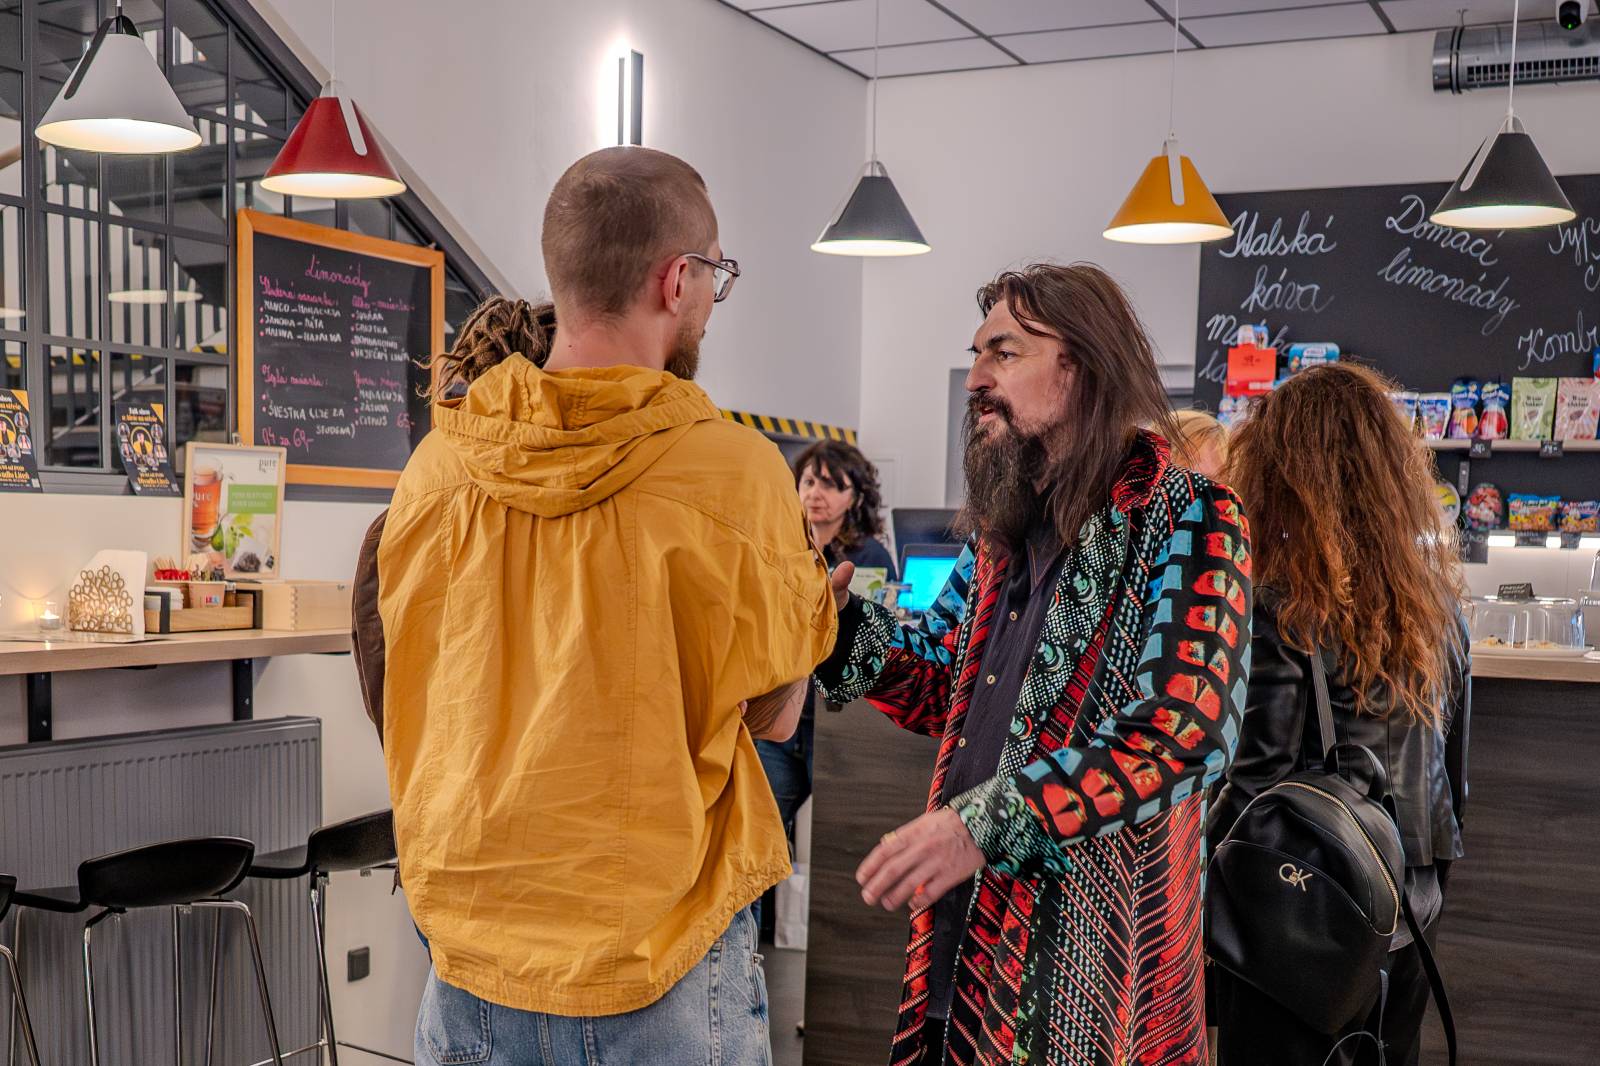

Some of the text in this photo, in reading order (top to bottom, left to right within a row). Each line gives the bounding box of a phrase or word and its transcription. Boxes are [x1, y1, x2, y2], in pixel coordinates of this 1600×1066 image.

[304, 254, 371, 298] Limonády
[1240, 264, 1336, 313] káva
[1377, 246, 1520, 336] limonády
[264, 300, 290, 313] MANGO
[264, 314, 296, 328] JAHODA
[265, 327, 294, 340] MALINA
[268, 399, 306, 421] ŠVESTKA
